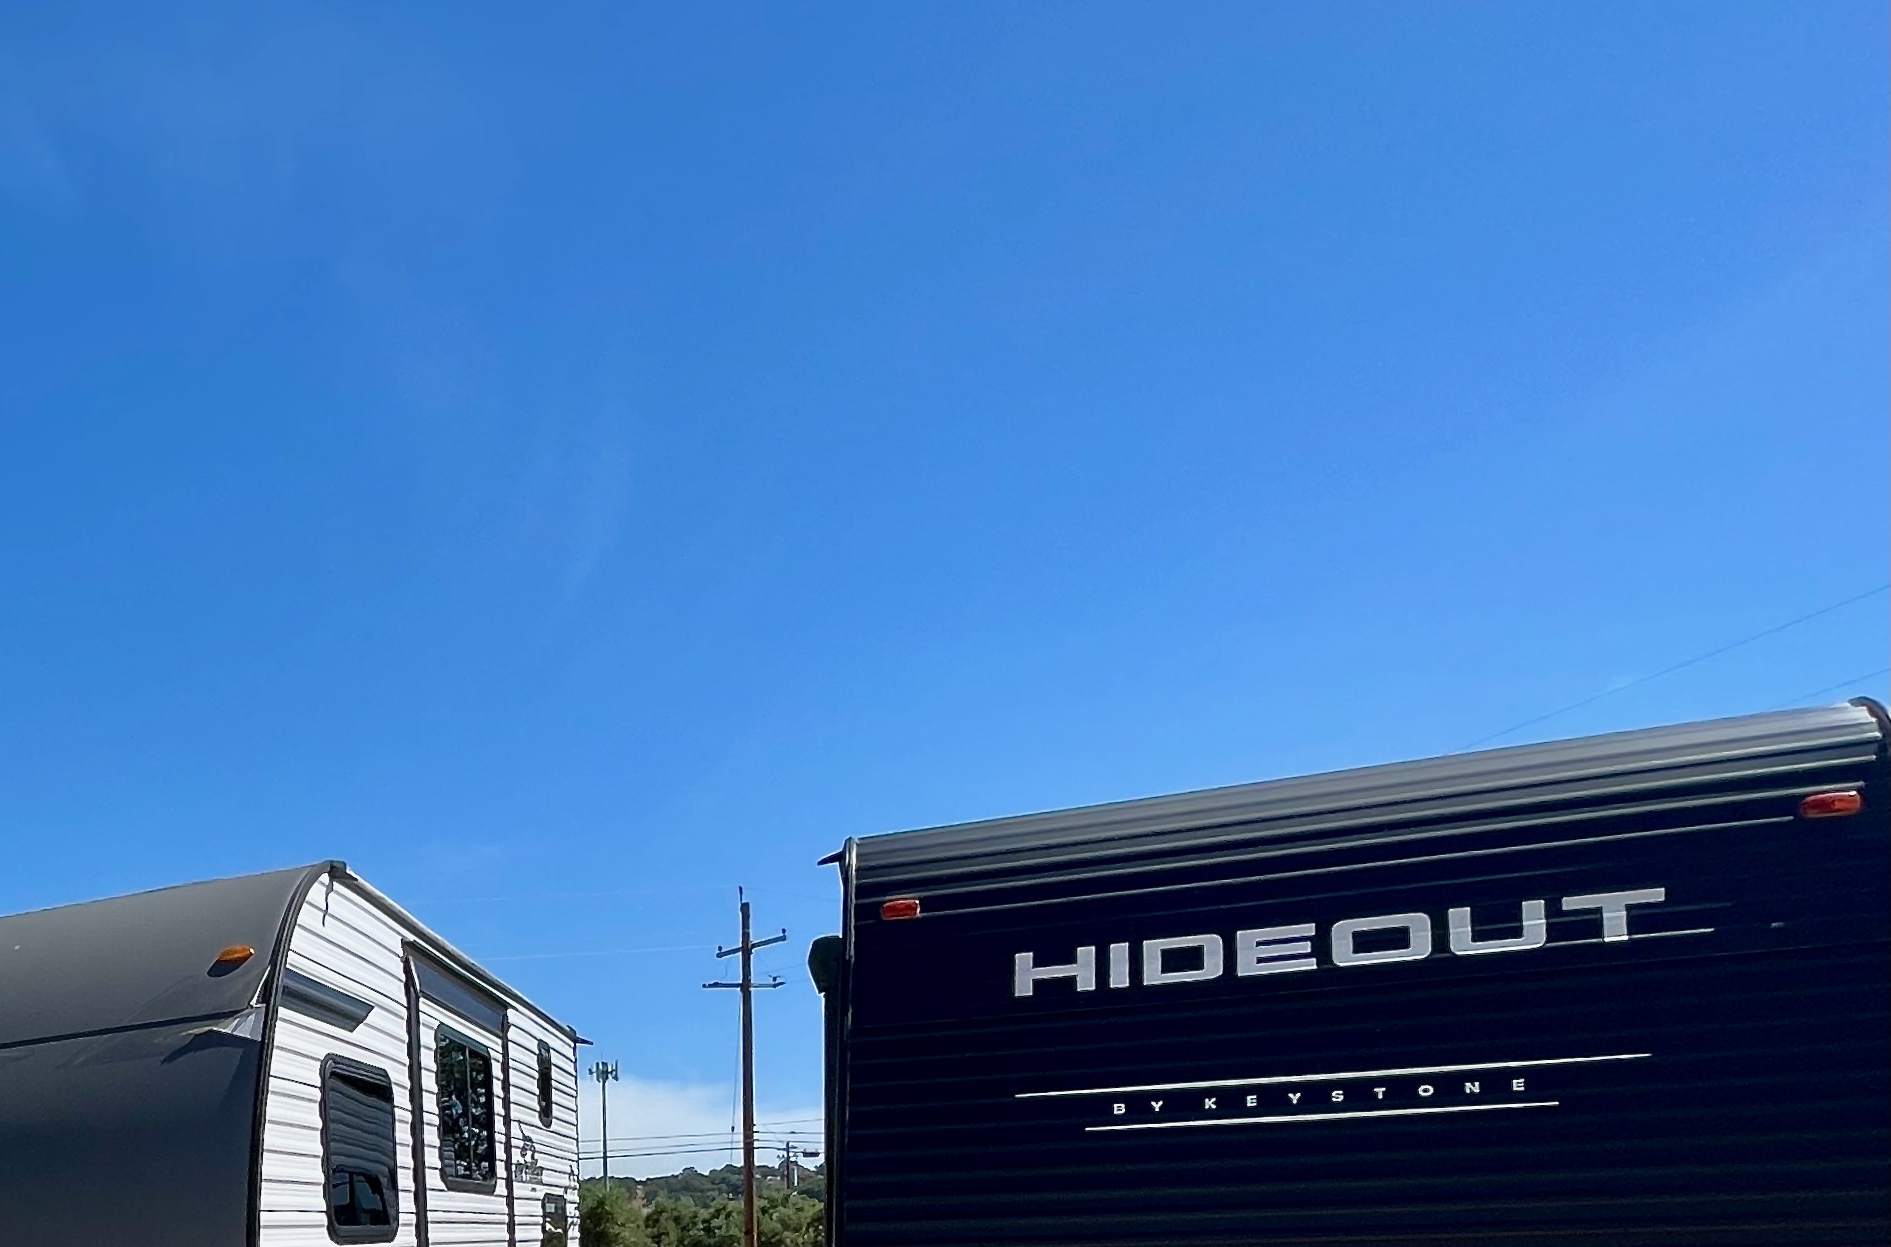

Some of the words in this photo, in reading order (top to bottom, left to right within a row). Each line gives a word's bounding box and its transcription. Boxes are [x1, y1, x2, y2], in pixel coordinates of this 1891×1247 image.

[1015, 887, 1666, 997] HIDEOUT
[1113, 1100, 1165, 1115] BY
[1204, 1078, 1526, 1110] KEYSTONE
